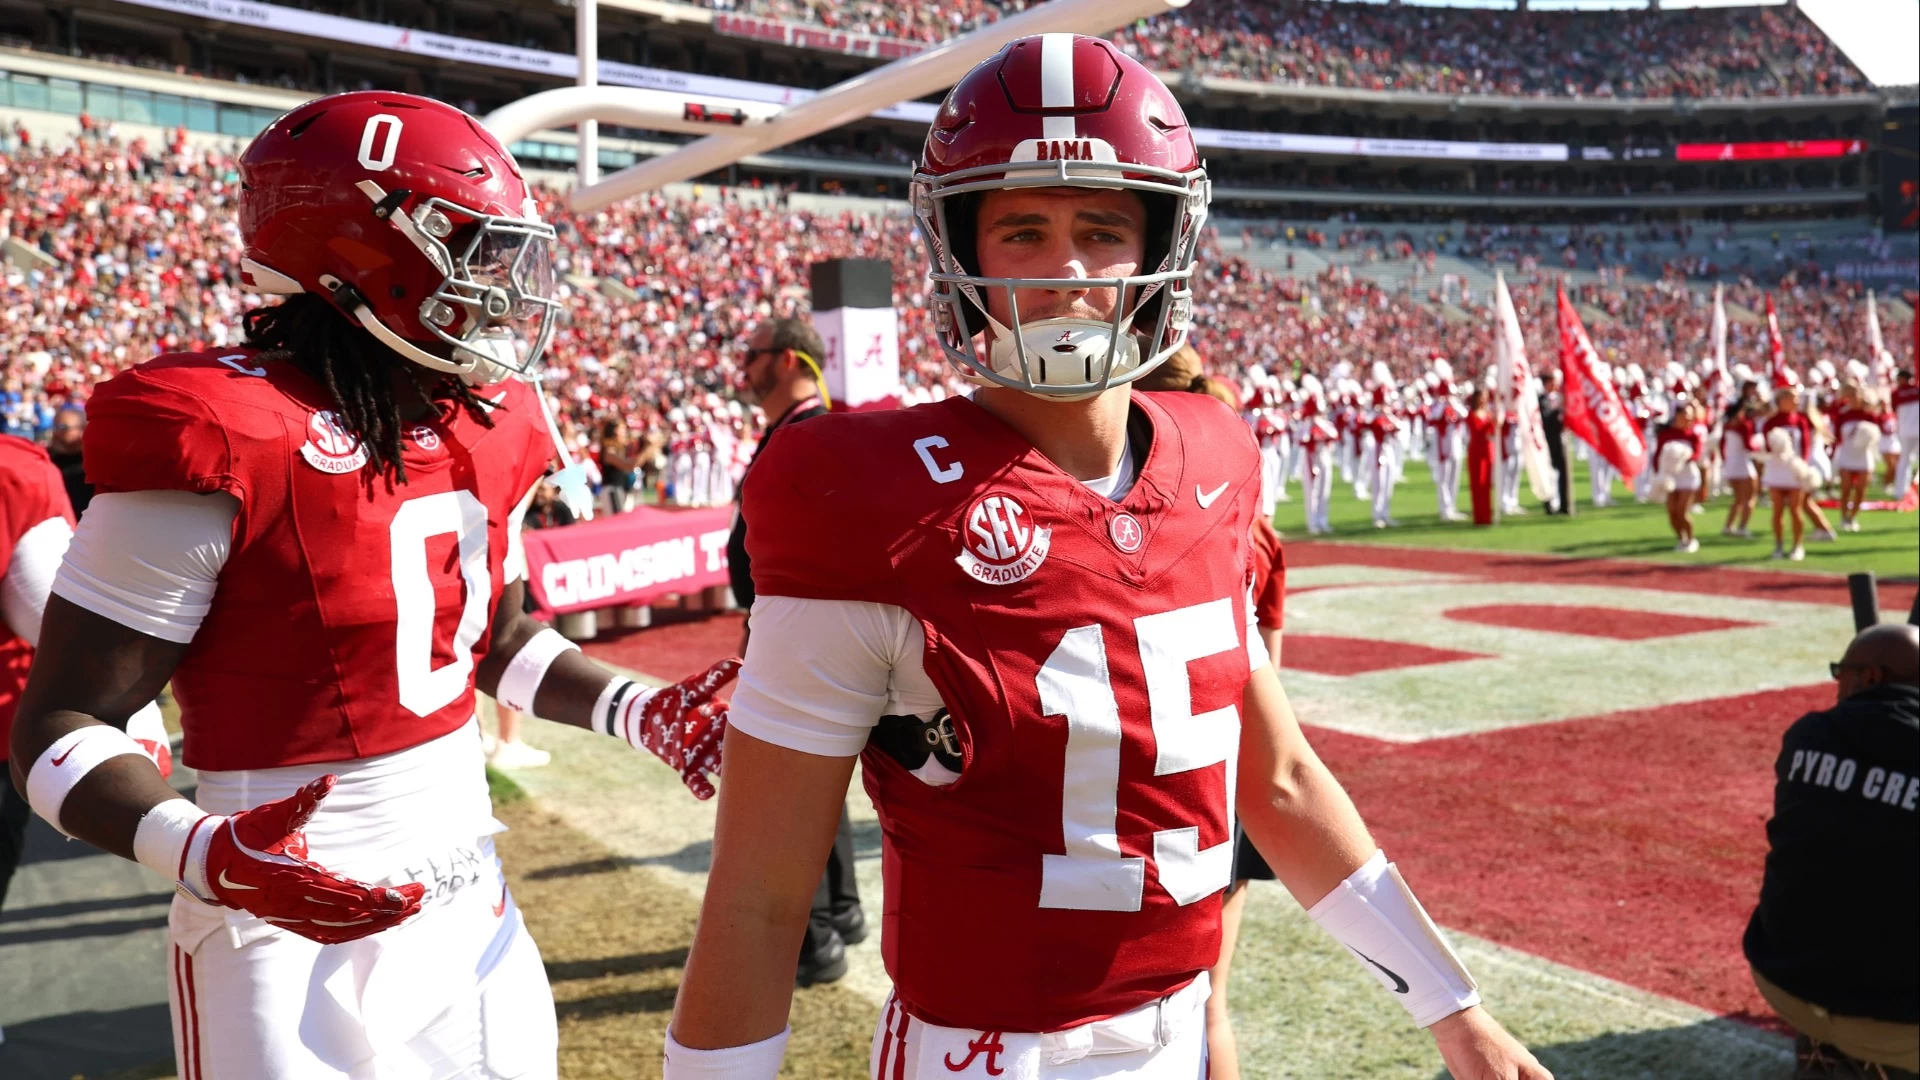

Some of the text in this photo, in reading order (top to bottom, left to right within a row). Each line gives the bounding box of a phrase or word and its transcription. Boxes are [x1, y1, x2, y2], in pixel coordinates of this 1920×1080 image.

[357, 113, 404, 171] 0
[1036, 140, 1094, 161] BAMA
[1055, 330, 1072, 342] A
[913, 435, 965, 484] C
[969, 496, 1029, 561] SEC
[1118, 519, 1137, 543] A
[542, 535, 696, 608] CRIMSON
[971, 545, 1045, 582] GRADUATE
[389, 488, 491, 719] 0
[1035, 597, 1241, 913] 15
[1788, 750, 1919, 811] PYRO CRE
[943, 1031, 1005, 1076] A
